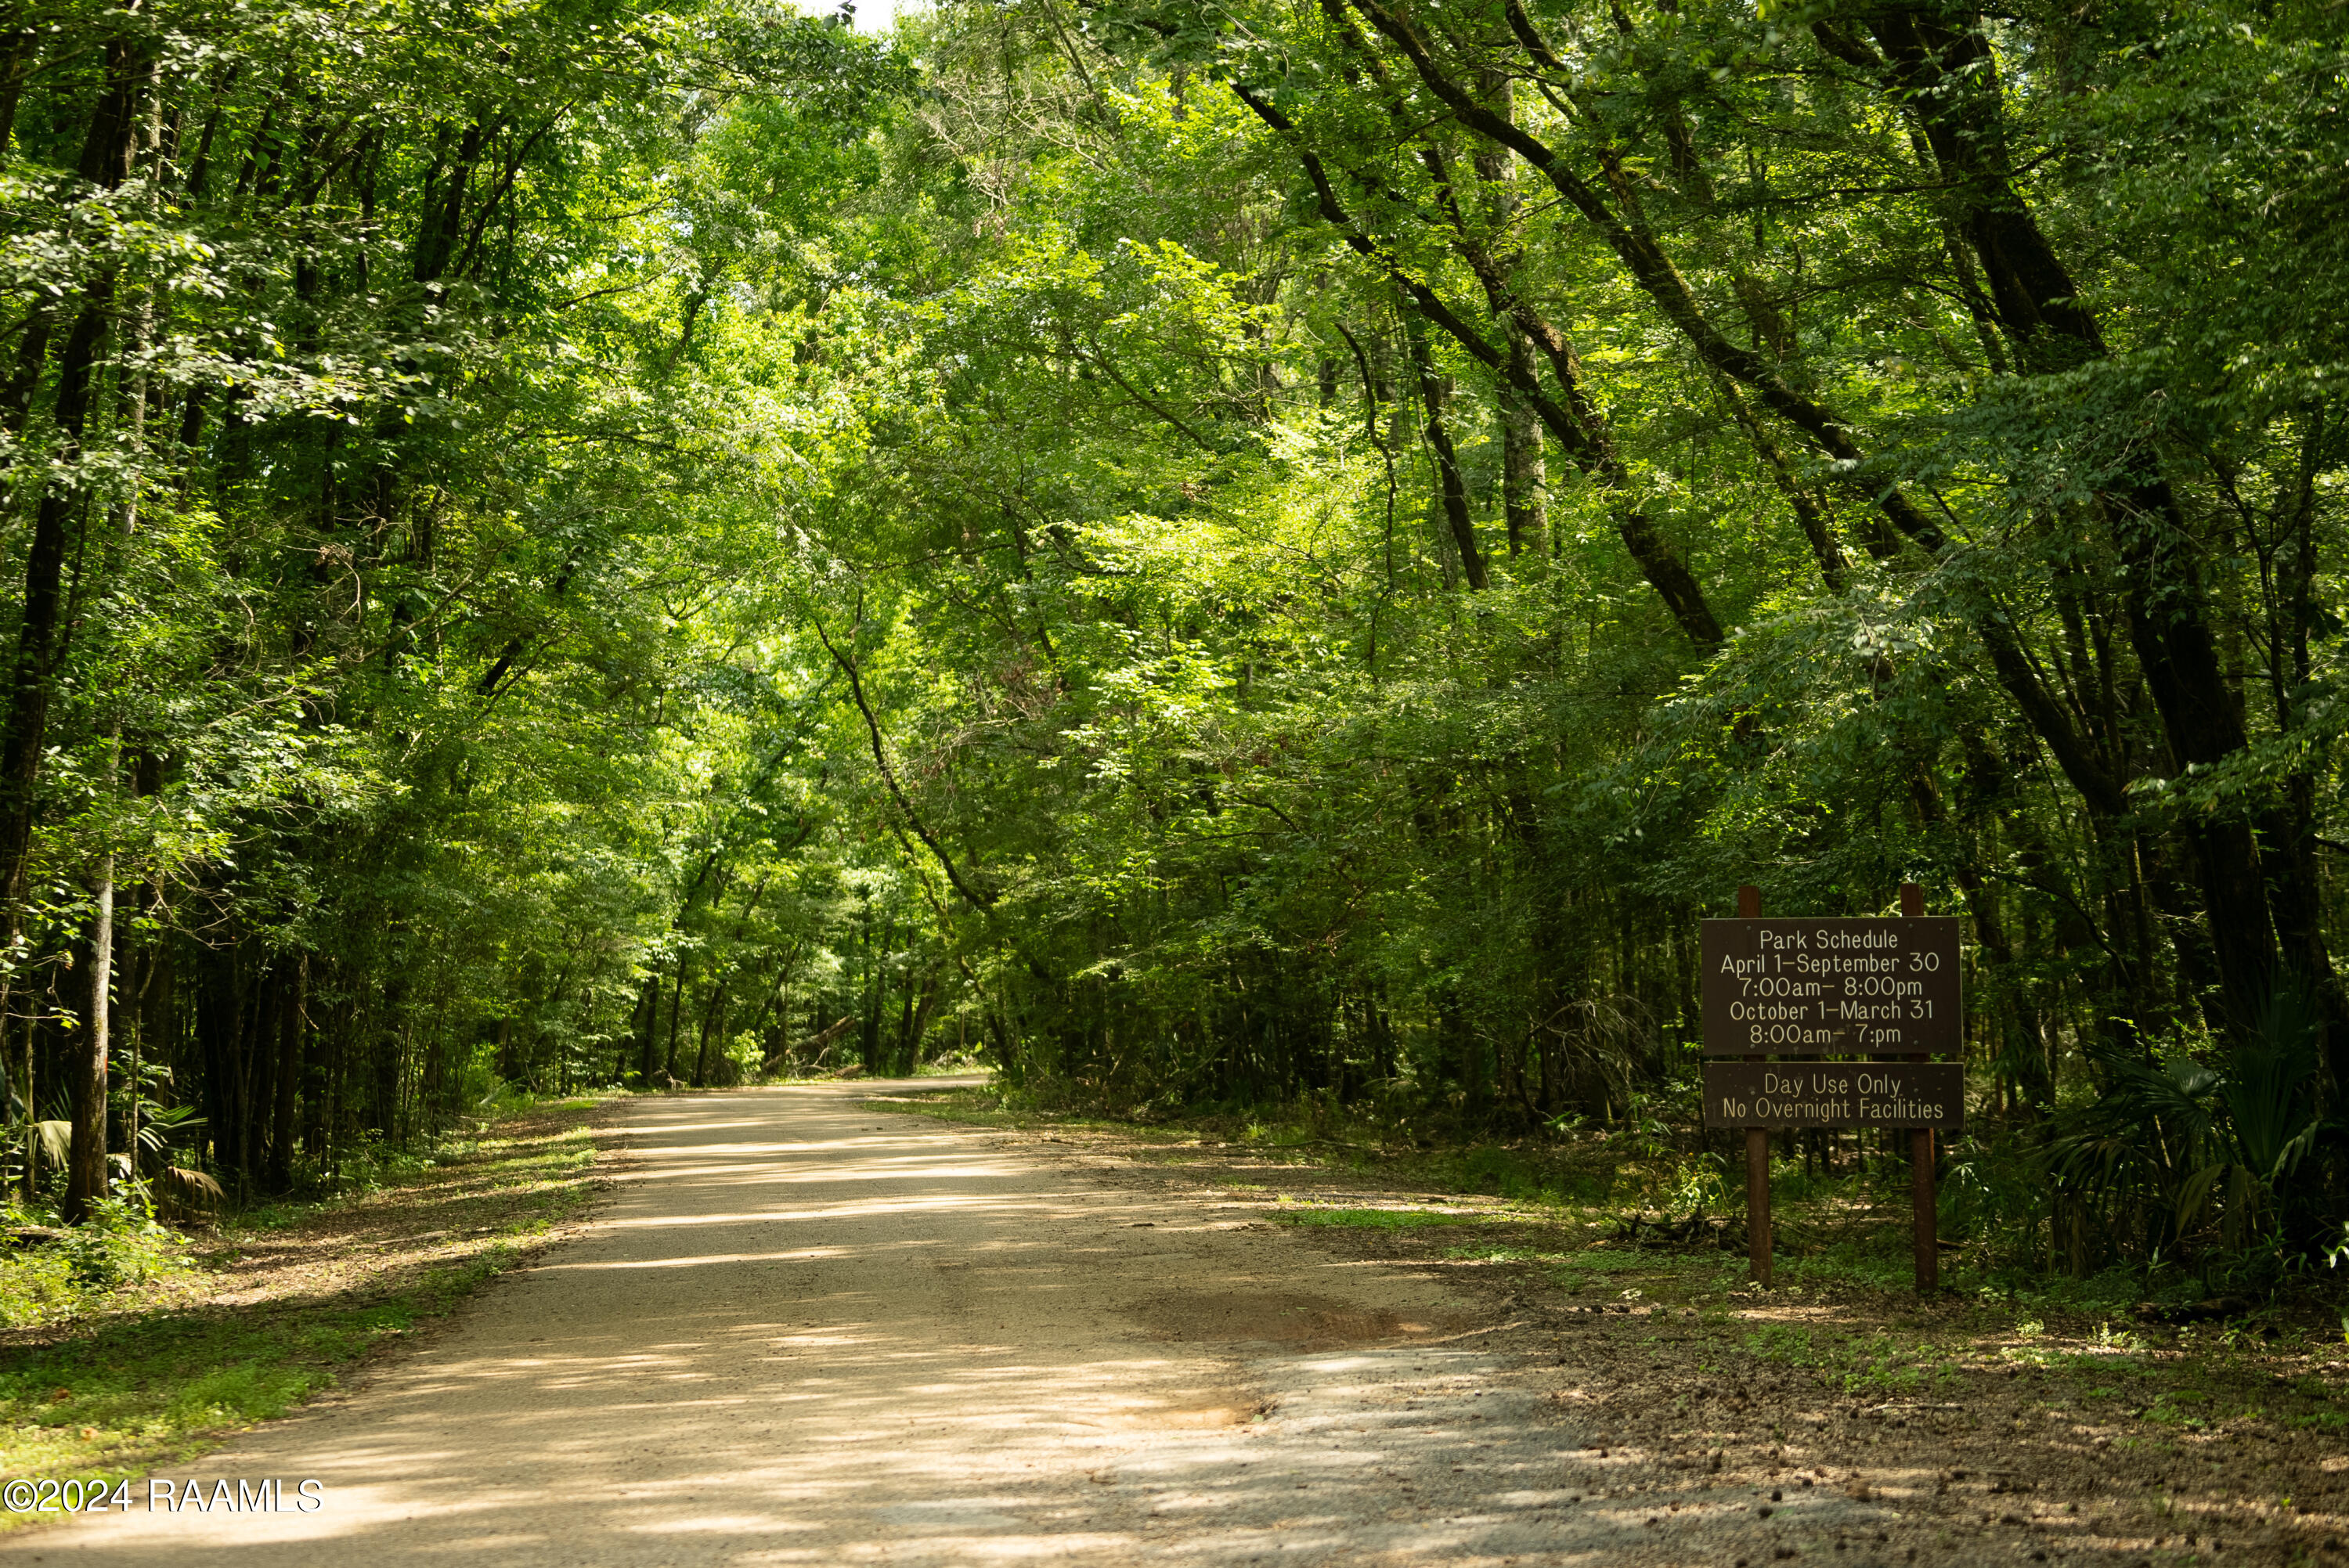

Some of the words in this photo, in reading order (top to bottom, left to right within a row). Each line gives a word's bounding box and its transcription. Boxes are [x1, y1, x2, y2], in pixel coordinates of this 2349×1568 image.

[1760, 930, 1807, 950] Park
[1816, 929, 1898, 949] Schedule
[1721, 953, 1765, 978] April
[1909, 952, 1939, 972] 30
[1844, 976, 1922, 1000] 8:00pm
[1730, 1001, 1808, 1020] October
[1910, 1000, 1932, 1019] 31
[1856, 1024, 1900, 1047] 7:pm
[1765, 1073, 1803, 1098] Day
[1813, 1073, 1848, 1094] Use
[1857, 1073, 1900, 1098] Only
[1723, 1098, 1746, 1118] No
[1755, 1098, 1850, 1122] Overnight
[1860, 1098, 1943, 1119] Facilities
